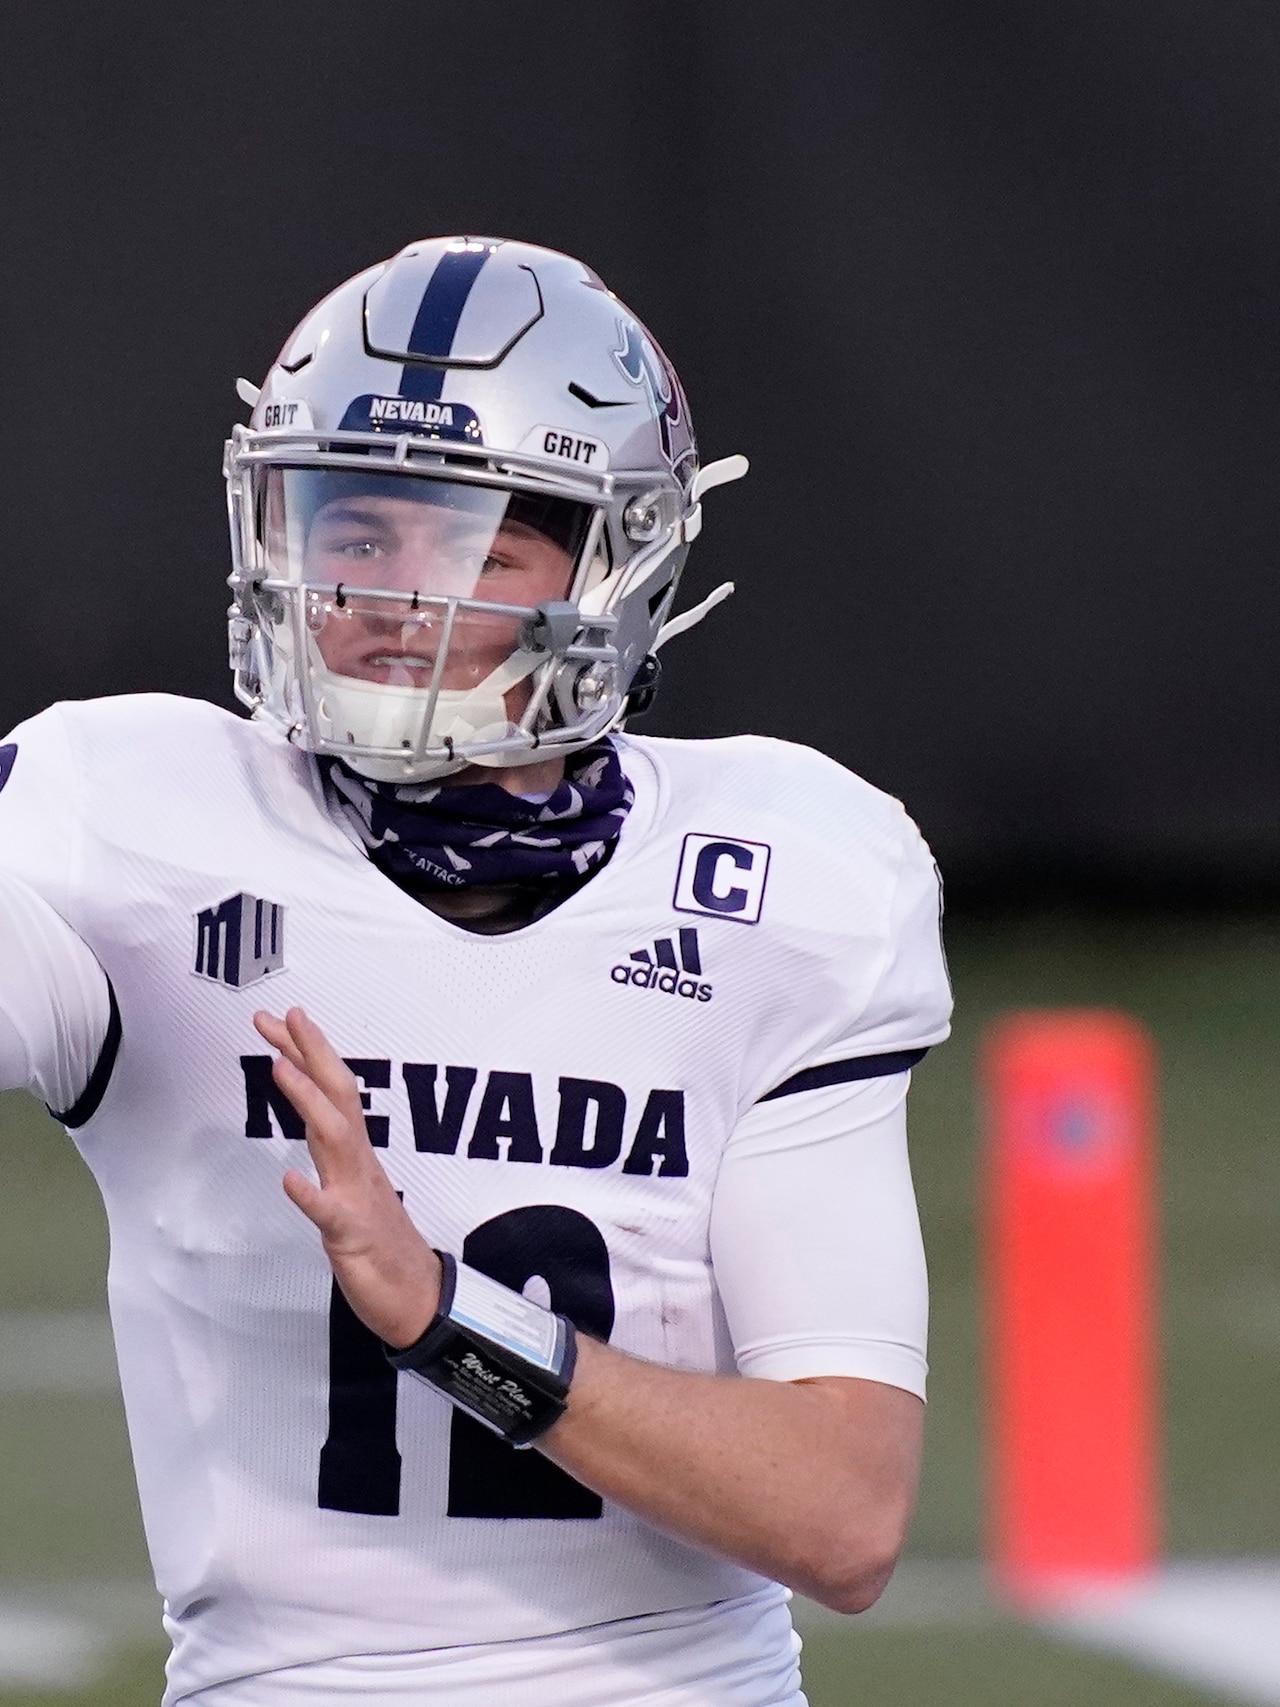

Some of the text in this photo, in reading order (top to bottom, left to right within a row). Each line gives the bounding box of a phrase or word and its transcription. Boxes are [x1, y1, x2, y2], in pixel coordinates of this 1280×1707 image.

[265, 403, 298, 427] GRIT
[370, 398, 454, 425] NEVADA
[544, 432, 596, 464] GRIT
[415, 857, 466, 885] ATTACK
[693, 842, 754, 913] C
[611, 963, 713, 1002] adidas
[240, 1054, 689, 1178] NEVADA
[318, 1191, 615, 1518] 12
[462, 1352, 500, 1384] Wrist
[497, 1380, 532, 1407] Plan
